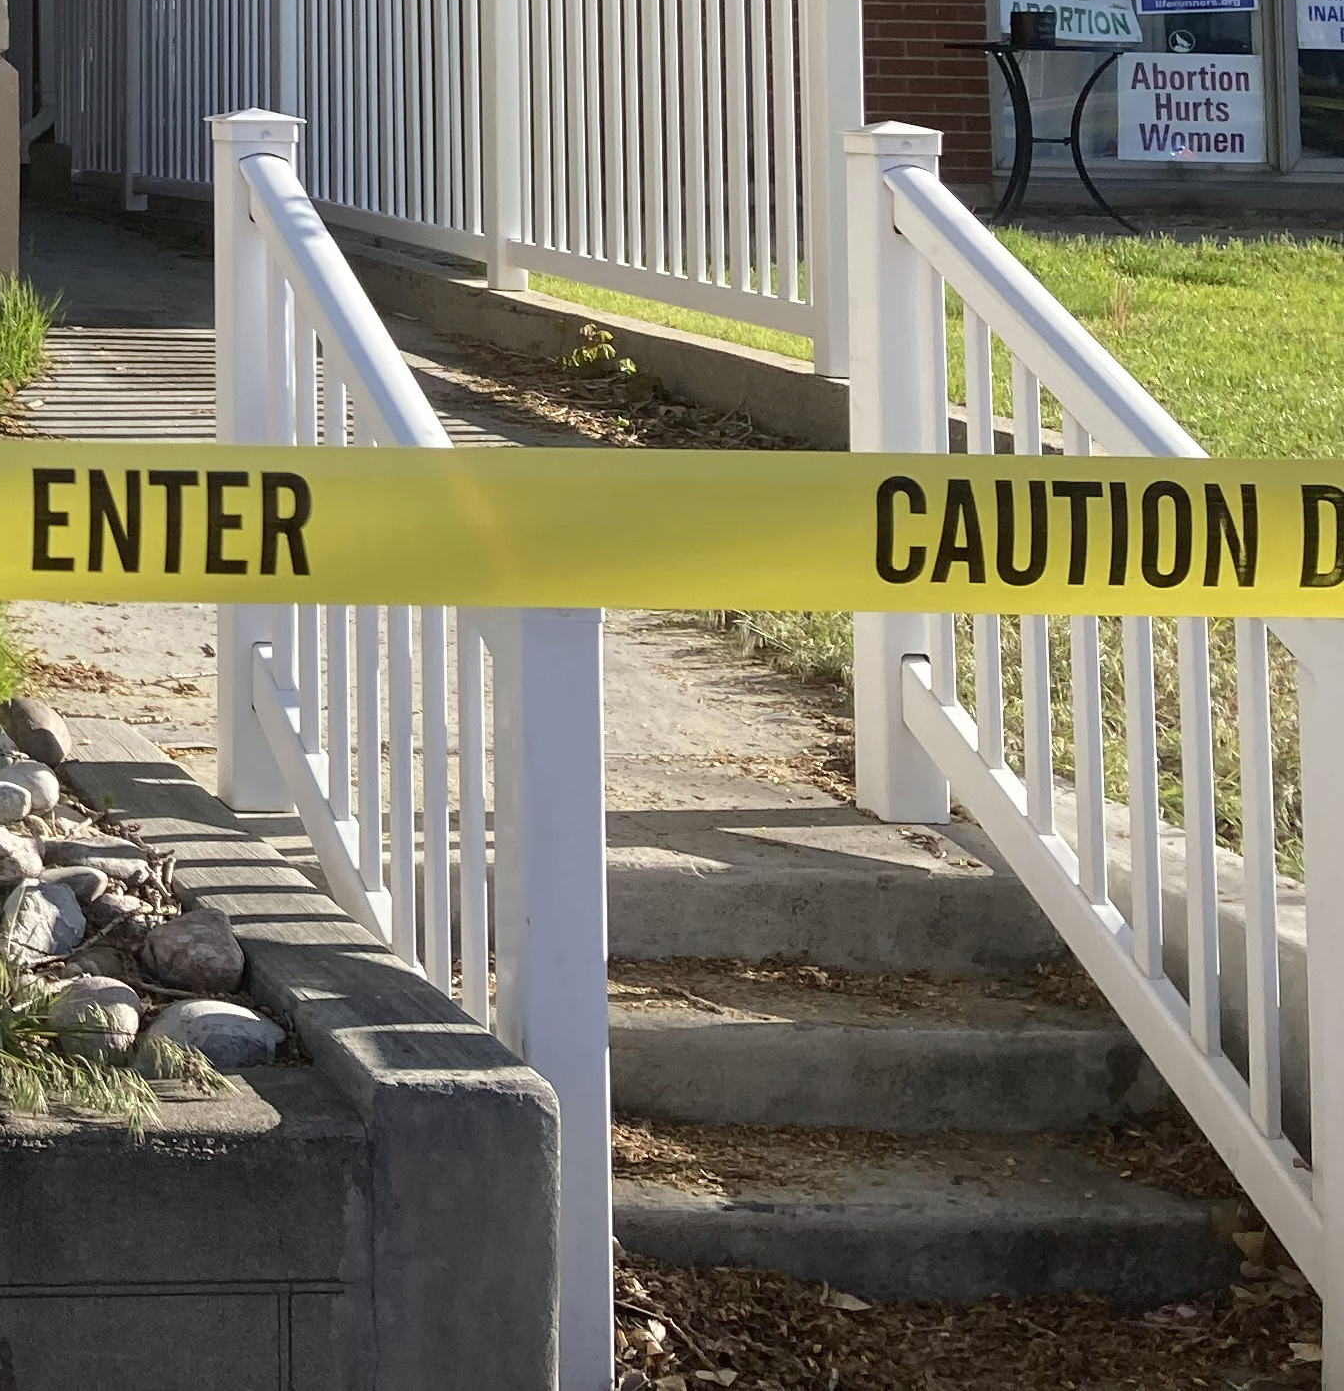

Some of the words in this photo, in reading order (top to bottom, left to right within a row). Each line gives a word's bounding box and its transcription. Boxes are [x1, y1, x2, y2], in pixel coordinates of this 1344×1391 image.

[1131, 61, 1250, 91] Abortion
[1155, 93, 1230, 122] Hurts
[1139, 123, 1245, 153] Women
[31, 468, 312, 576] ENTER
[876, 475, 1259, 589] CAUTION
